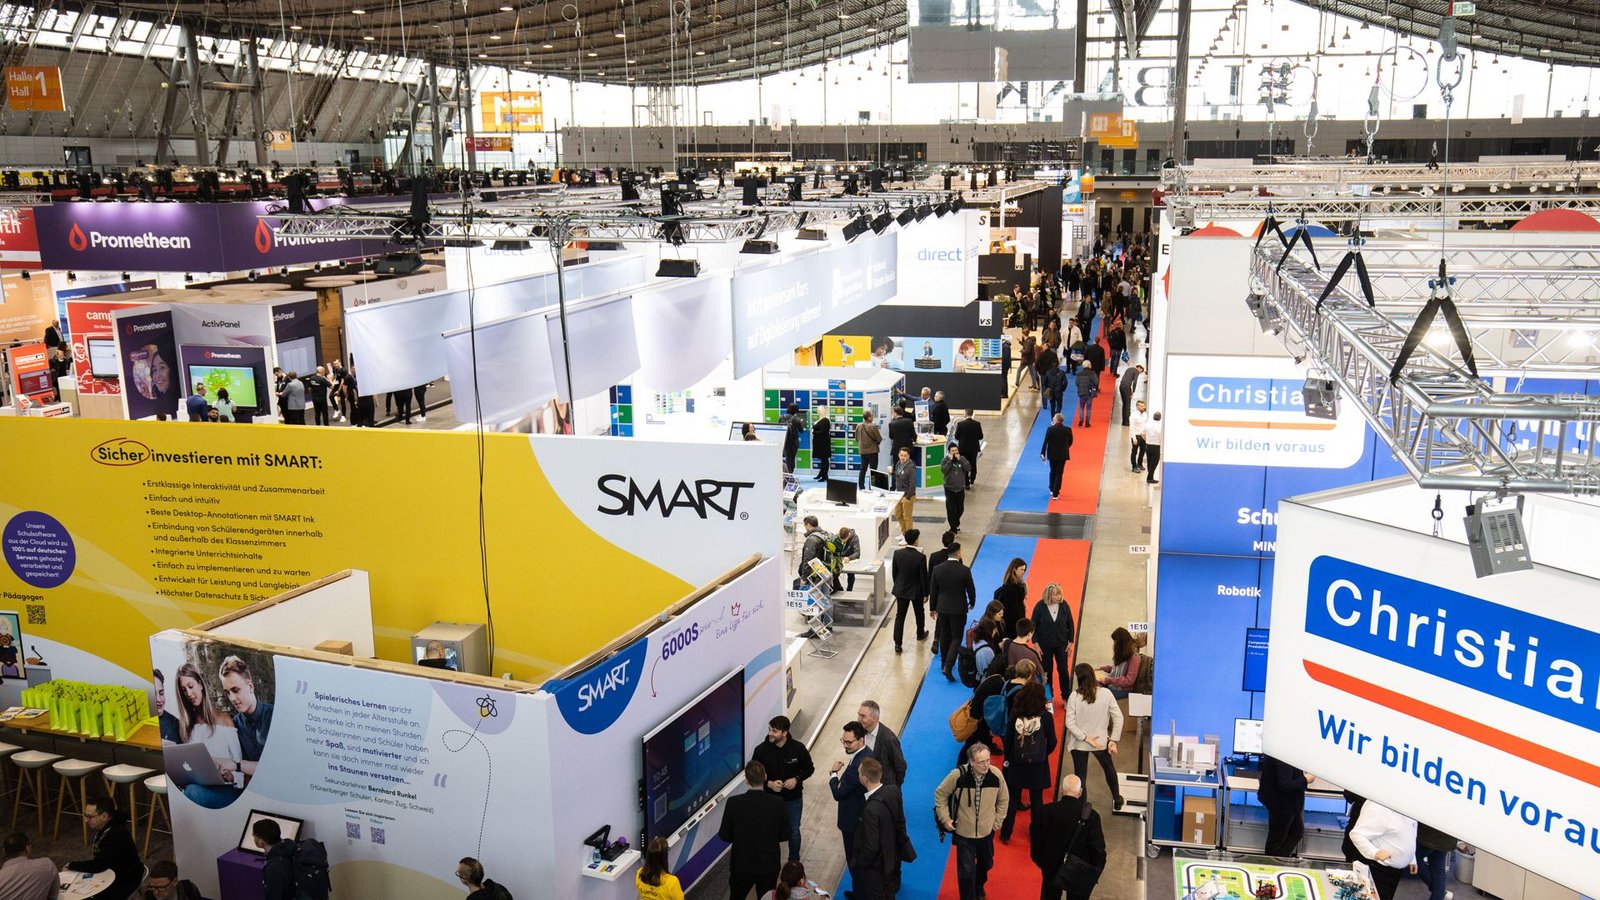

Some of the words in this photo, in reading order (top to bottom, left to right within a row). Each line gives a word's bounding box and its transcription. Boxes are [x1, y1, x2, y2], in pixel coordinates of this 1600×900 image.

[8, 71, 32, 82] Halle
[34, 72, 48, 96] 1
[11, 86, 30, 97] Hall
[90, 231, 191, 249] Promethean
[274, 310, 295, 322] ctivPanel
[134, 322, 167, 333] Promethean
[202, 320, 240, 329] ActivPanel
[211, 352, 242, 360] Promethean
[1196, 437, 1222, 450] Wir
[1226, 438, 1270, 452] bilden
[1276, 442, 1326, 454] voraus
[98, 446, 145, 462] Sicher
[151, 449, 232, 466] investieren
[236, 454, 261, 466] mit
[265, 454, 323, 470] SMART:
[146, 480, 192, 490] Erstklassige
[192, 482, 241, 492] Interaktivität
[242, 484, 258, 492] und
[259, 485, 326, 496] Zusammenarbeit
[149, 494, 177, 502] Einfach
[178, 496, 194, 504] und
[150, 508, 172, 516] Beste
[172, 510, 258, 520] Desktop-Annotationen
[259, 513, 272, 521] mit
[274, 514, 301, 522] SMART
[17, 530, 56, 538] Schulsoftware
[152, 522, 194, 534] Einbindung
[212, 525, 284, 536] Schülerendgeräten
[286, 528, 323, 538] innerhalb
[154, 534, 168, 542] und
[170, 535, 209, 544] außerhalb
[225, 538, 287, 548] Klassenzimmers
[156, 548, 194, 558] Integrierte
[196, 550, 263, 560] Unterrichtsinhalte
[157, 562, 184, 570] Einfach
[196, 564, 255, 574] implementieren
[256, 566, 272, 574] und
[159, 575, 196, 584] Entwickelt
[197, 576, 208, 585] für
[210, 578, 242, 588] Leistung
[242, 580, 258, 588] und
[4, 592, 44, 602] Pädagogen
[160, 588, 194, 598] Höchster
[194, 590, 242, 600] Datenschutz
[243, 593, 249, 601] &
[1217, 584, 1261, 598] Robotik
[662, 622, 698, 661] 6000S
[1326, 578, 1600, 711] Christia
[314, 692, 360, 706] Spielerisches
[362, 700, 387, 710] Lernen
[388, 704, 412, 715] spricht
[308, 702, 343, 714] Menschen
[344, 708, 351, 716] in
[352, 708, 370, 719] jeder
[372, 714, 408, 726] Altersstufe
[410, 720, 421, 729] an.
[308, 713, 322, 723] Das
[322, 717, 344, 726] merke
[345, 720, 356, 729] ich
[357, 722, 364, 730] in
[364, 724, 391, 734] meinen
[392, 728, 424, 741] Stunden.
[304, 724, 316, 733] Die
[318, 726, 362, 741] Schülerinnen
[363, 734, 377, 744] und
[378, 737, 404, 749] Schüler
[405, 742, 430, 754] haben
[306, 736, 324, 746] mehr
[326, 740, 346, 751] Spaß,
[346, 743, 362, 753] sind
[362, 747, 402, 760] motivierter
[404, 753, 418, 762] und
[419, 756, 430, 766] ich
[1318, 709, 1372, 756] Wir
[1381, 736, 1487, 806] bilden
[312, 748, 330, 758] kann
[330, 752, 341, 761] sie
[342, 754, 360, 764] doch
[360, 757, 384, 768] immer
[384, 762, 399, 772] mal
[400, 764, 425, 776] wieder
[328, 762, 339, 772] ins
[340, 764, 369, 777] Staunen
[324, 776, 368, 791] Sekundarlehrer
[368, 785, 396, 796] Bernhard
[396, 790, 418, 800] Runkel
[349, 790, 374, 802] Schulen,
[374, 796, 395, 806] Kanton
[395, 800, 408, 810] Zug,
